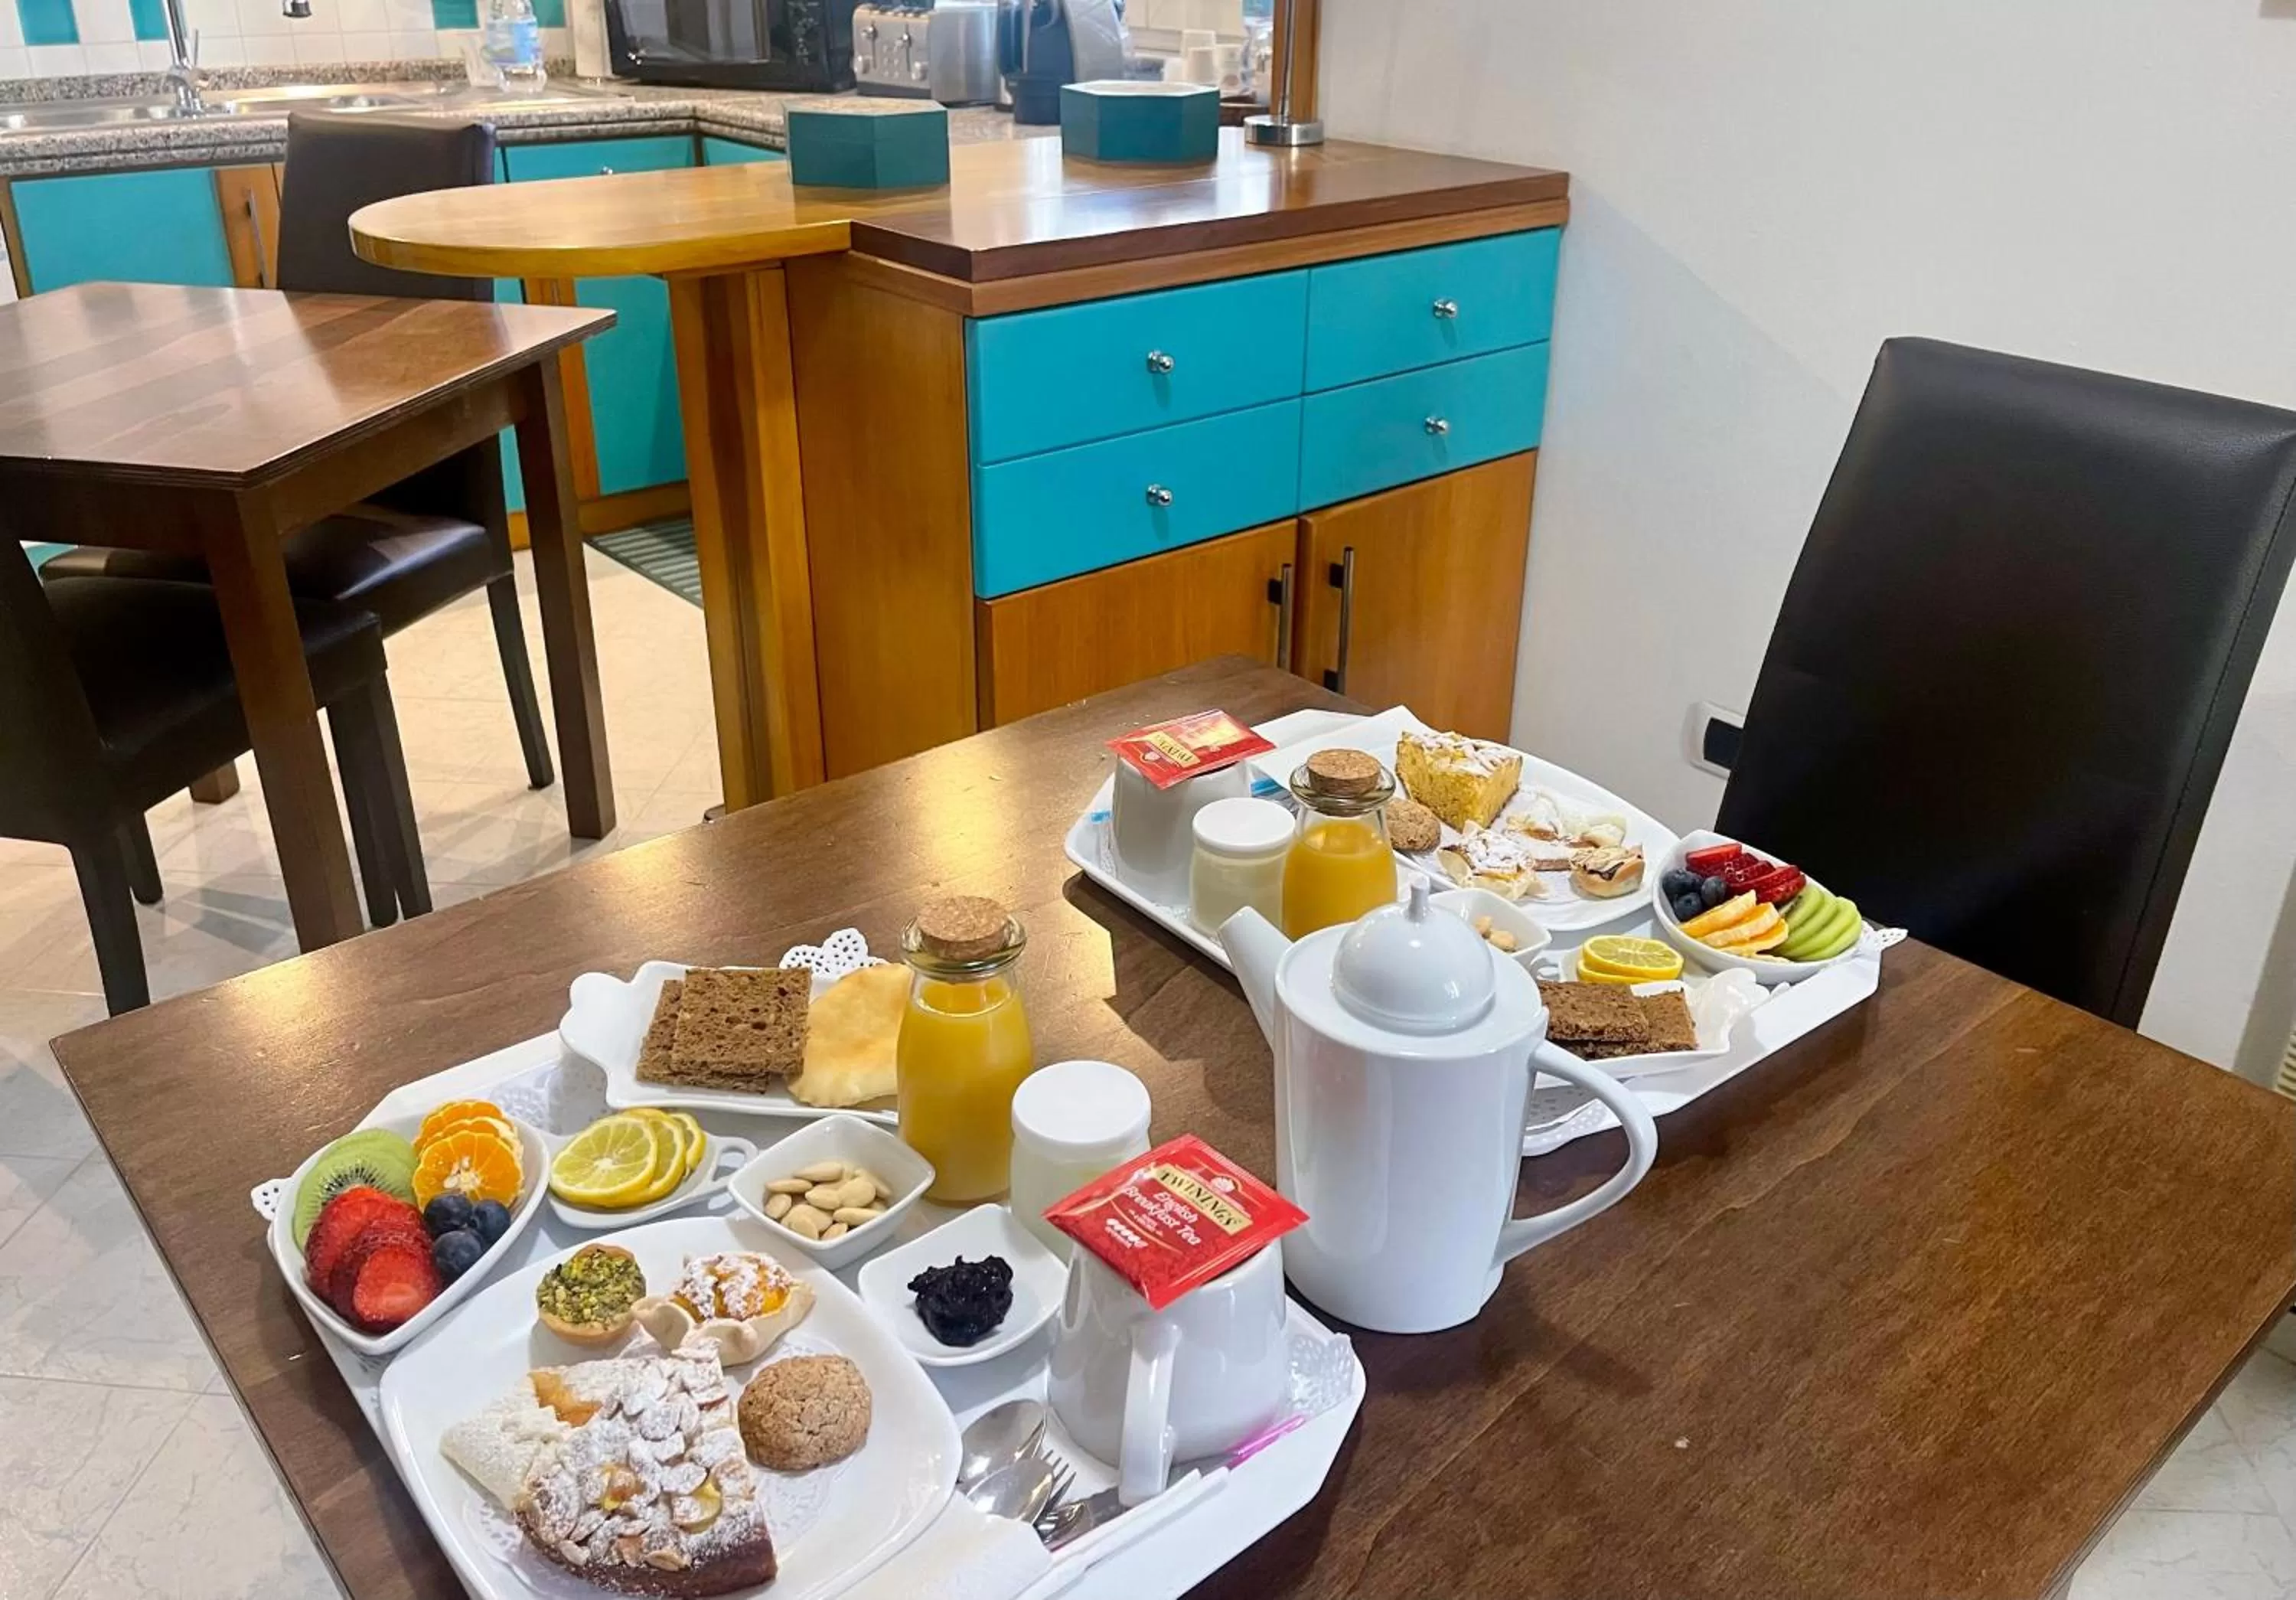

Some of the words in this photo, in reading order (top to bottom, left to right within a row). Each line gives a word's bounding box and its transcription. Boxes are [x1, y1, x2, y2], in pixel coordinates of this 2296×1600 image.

[1125, 1186, 1181, 1228] Breakfast
[1177, 1224, 1202, 1246] Tea
[1154, 1191, 1199, 1224] English
[1161, 1171, 1238, 1226] TWININGS
